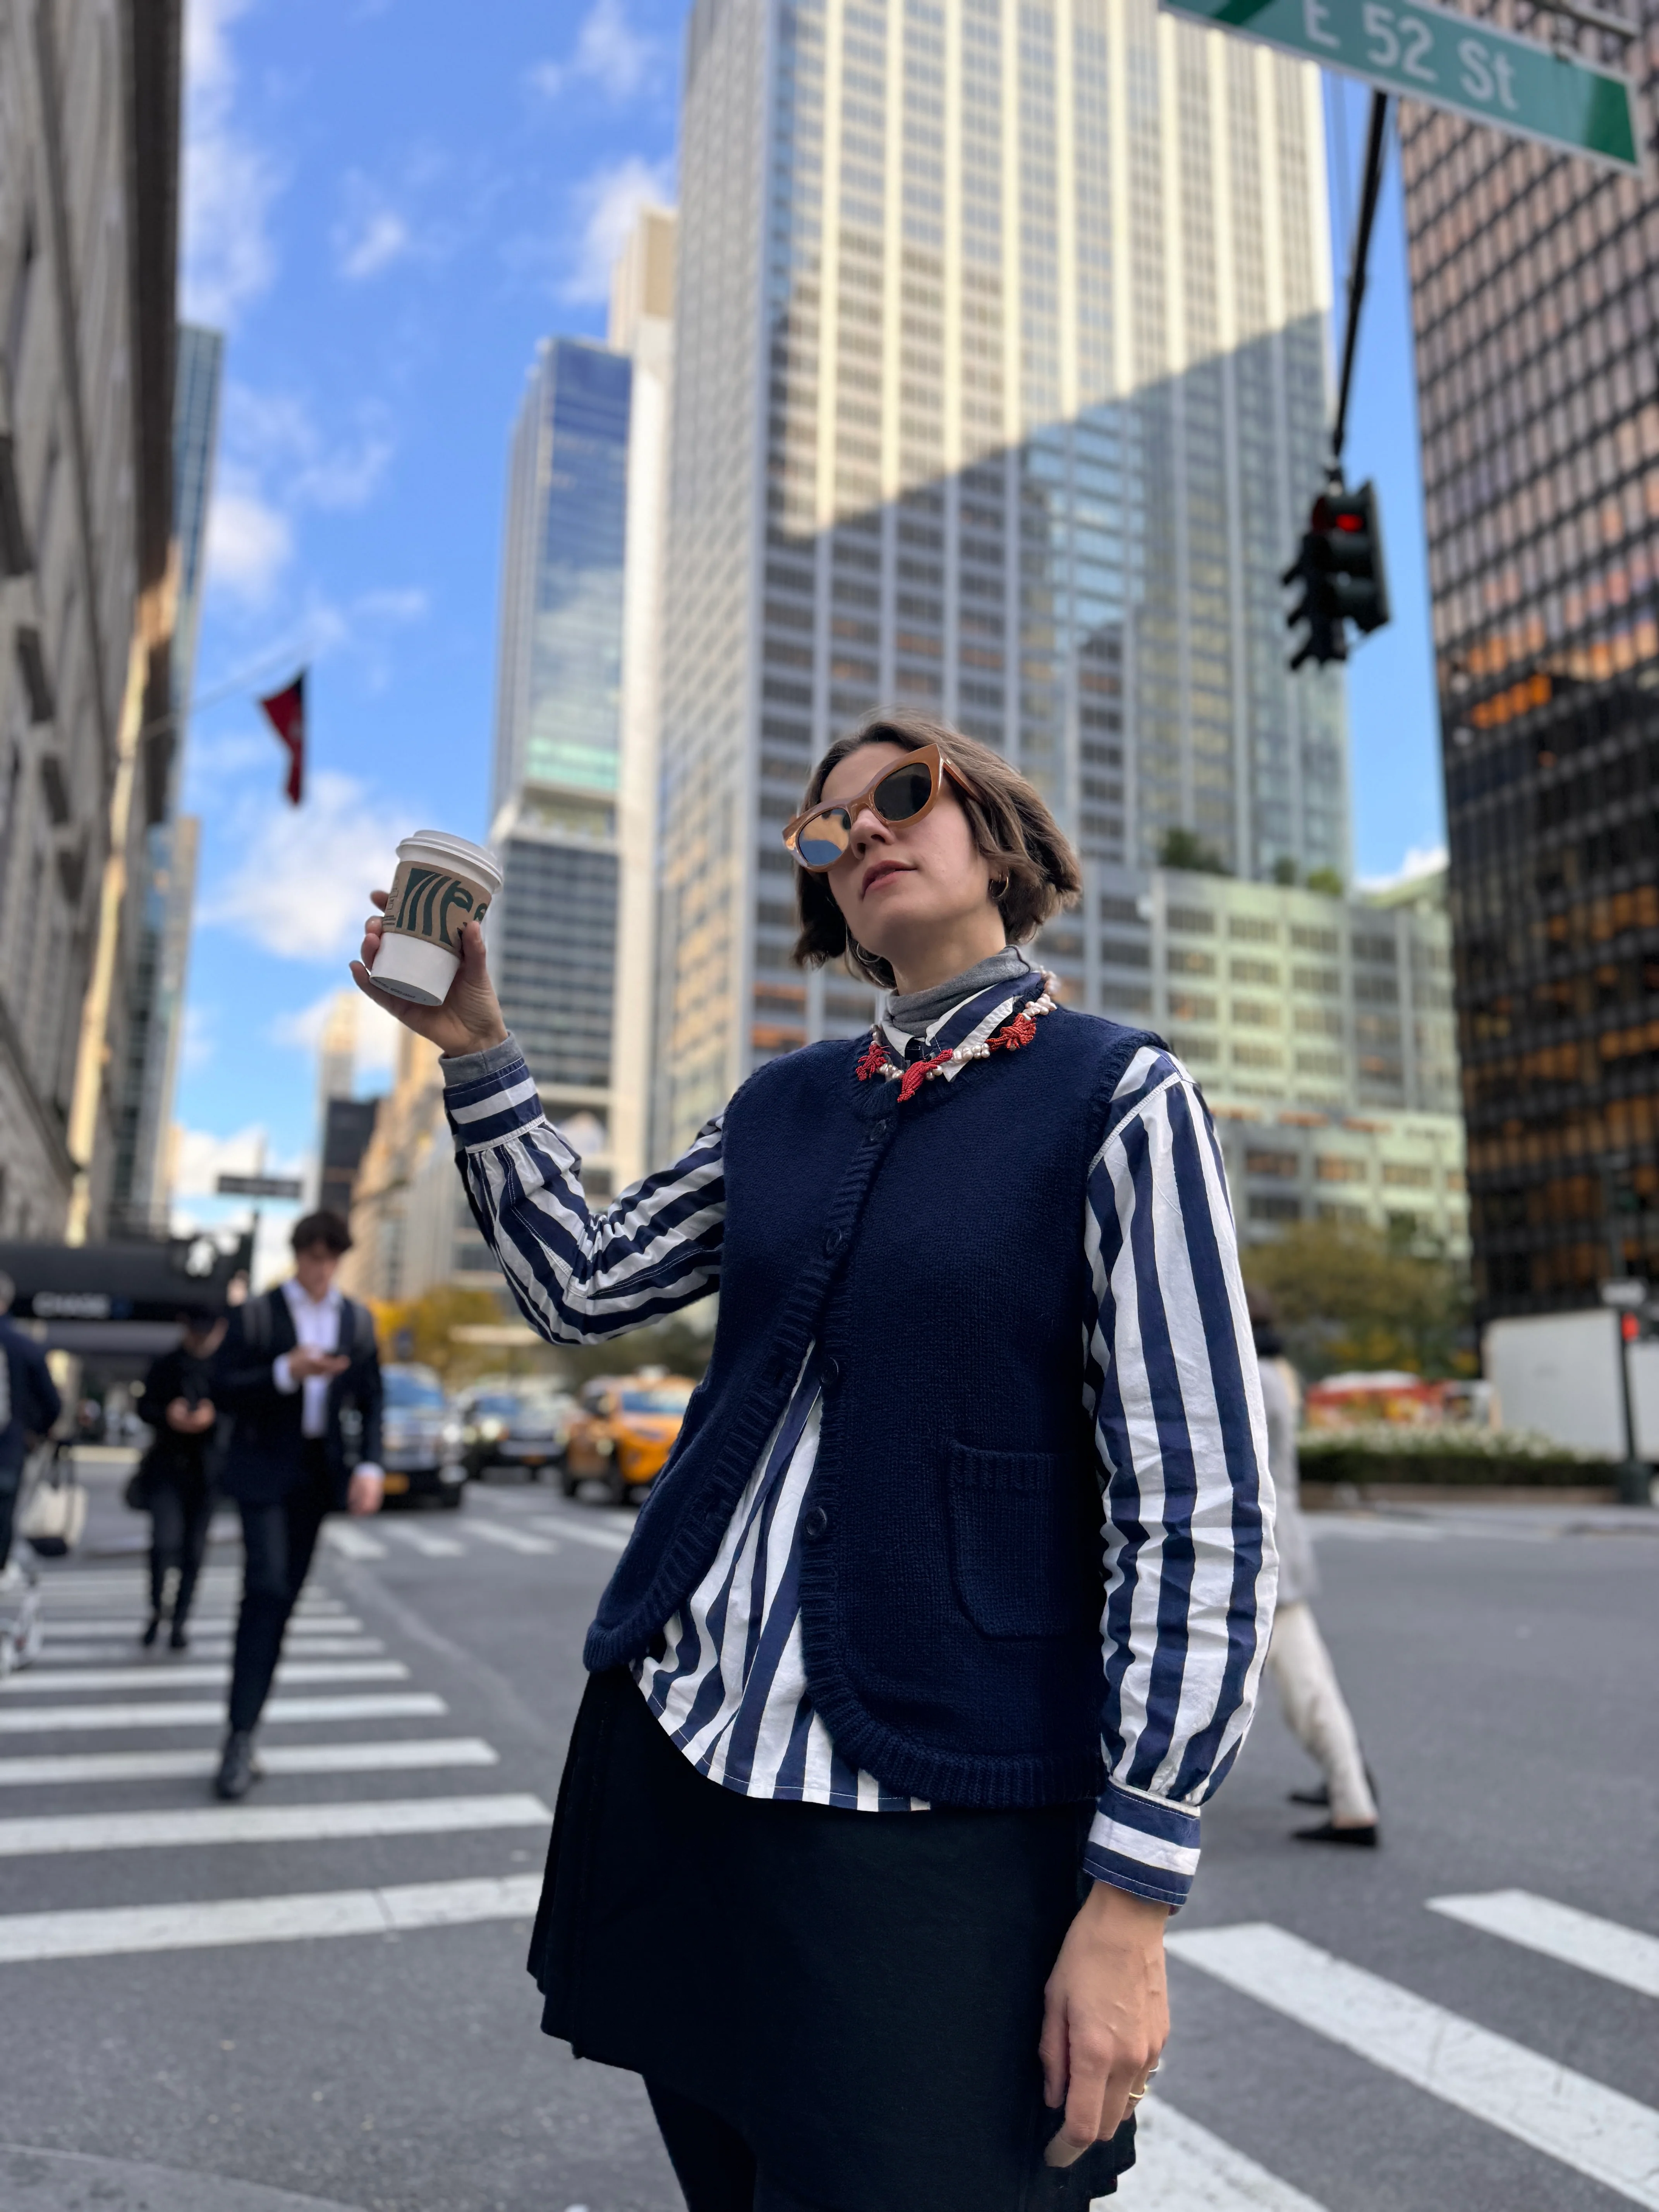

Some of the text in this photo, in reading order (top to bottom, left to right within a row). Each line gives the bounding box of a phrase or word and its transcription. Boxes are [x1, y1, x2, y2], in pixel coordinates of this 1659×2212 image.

[1303, 0, 1520, 111] E 52 St
